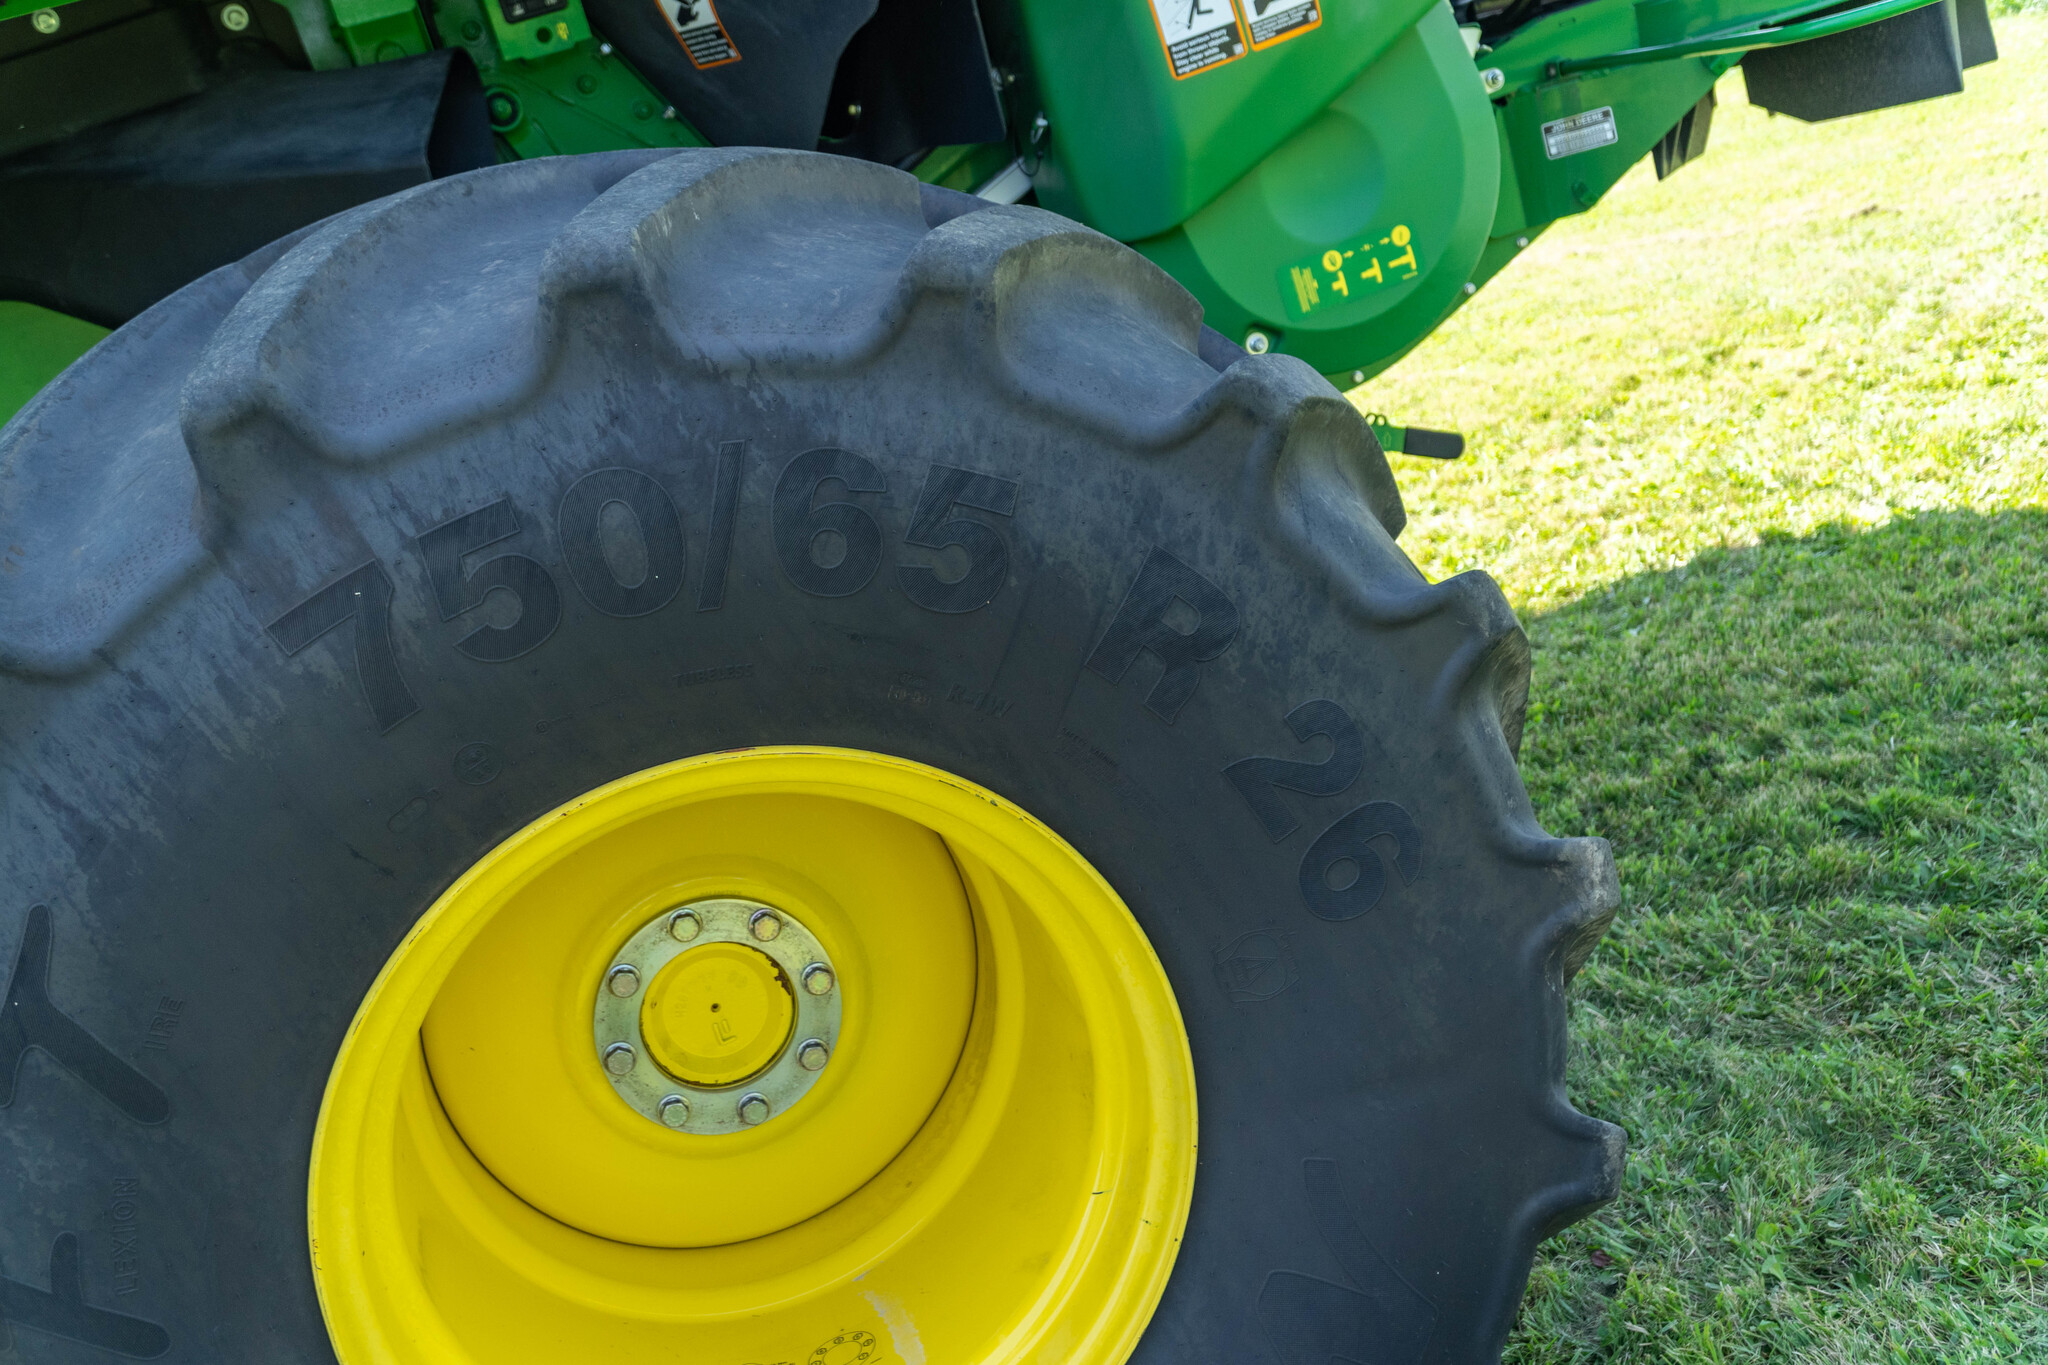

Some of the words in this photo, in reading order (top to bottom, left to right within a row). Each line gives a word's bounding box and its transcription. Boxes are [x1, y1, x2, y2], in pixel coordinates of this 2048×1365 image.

[264, 438, 1020, 736] 750/65
[1085, 543, 1241, 726] R
[1220, 698, 1424, 923] 26
